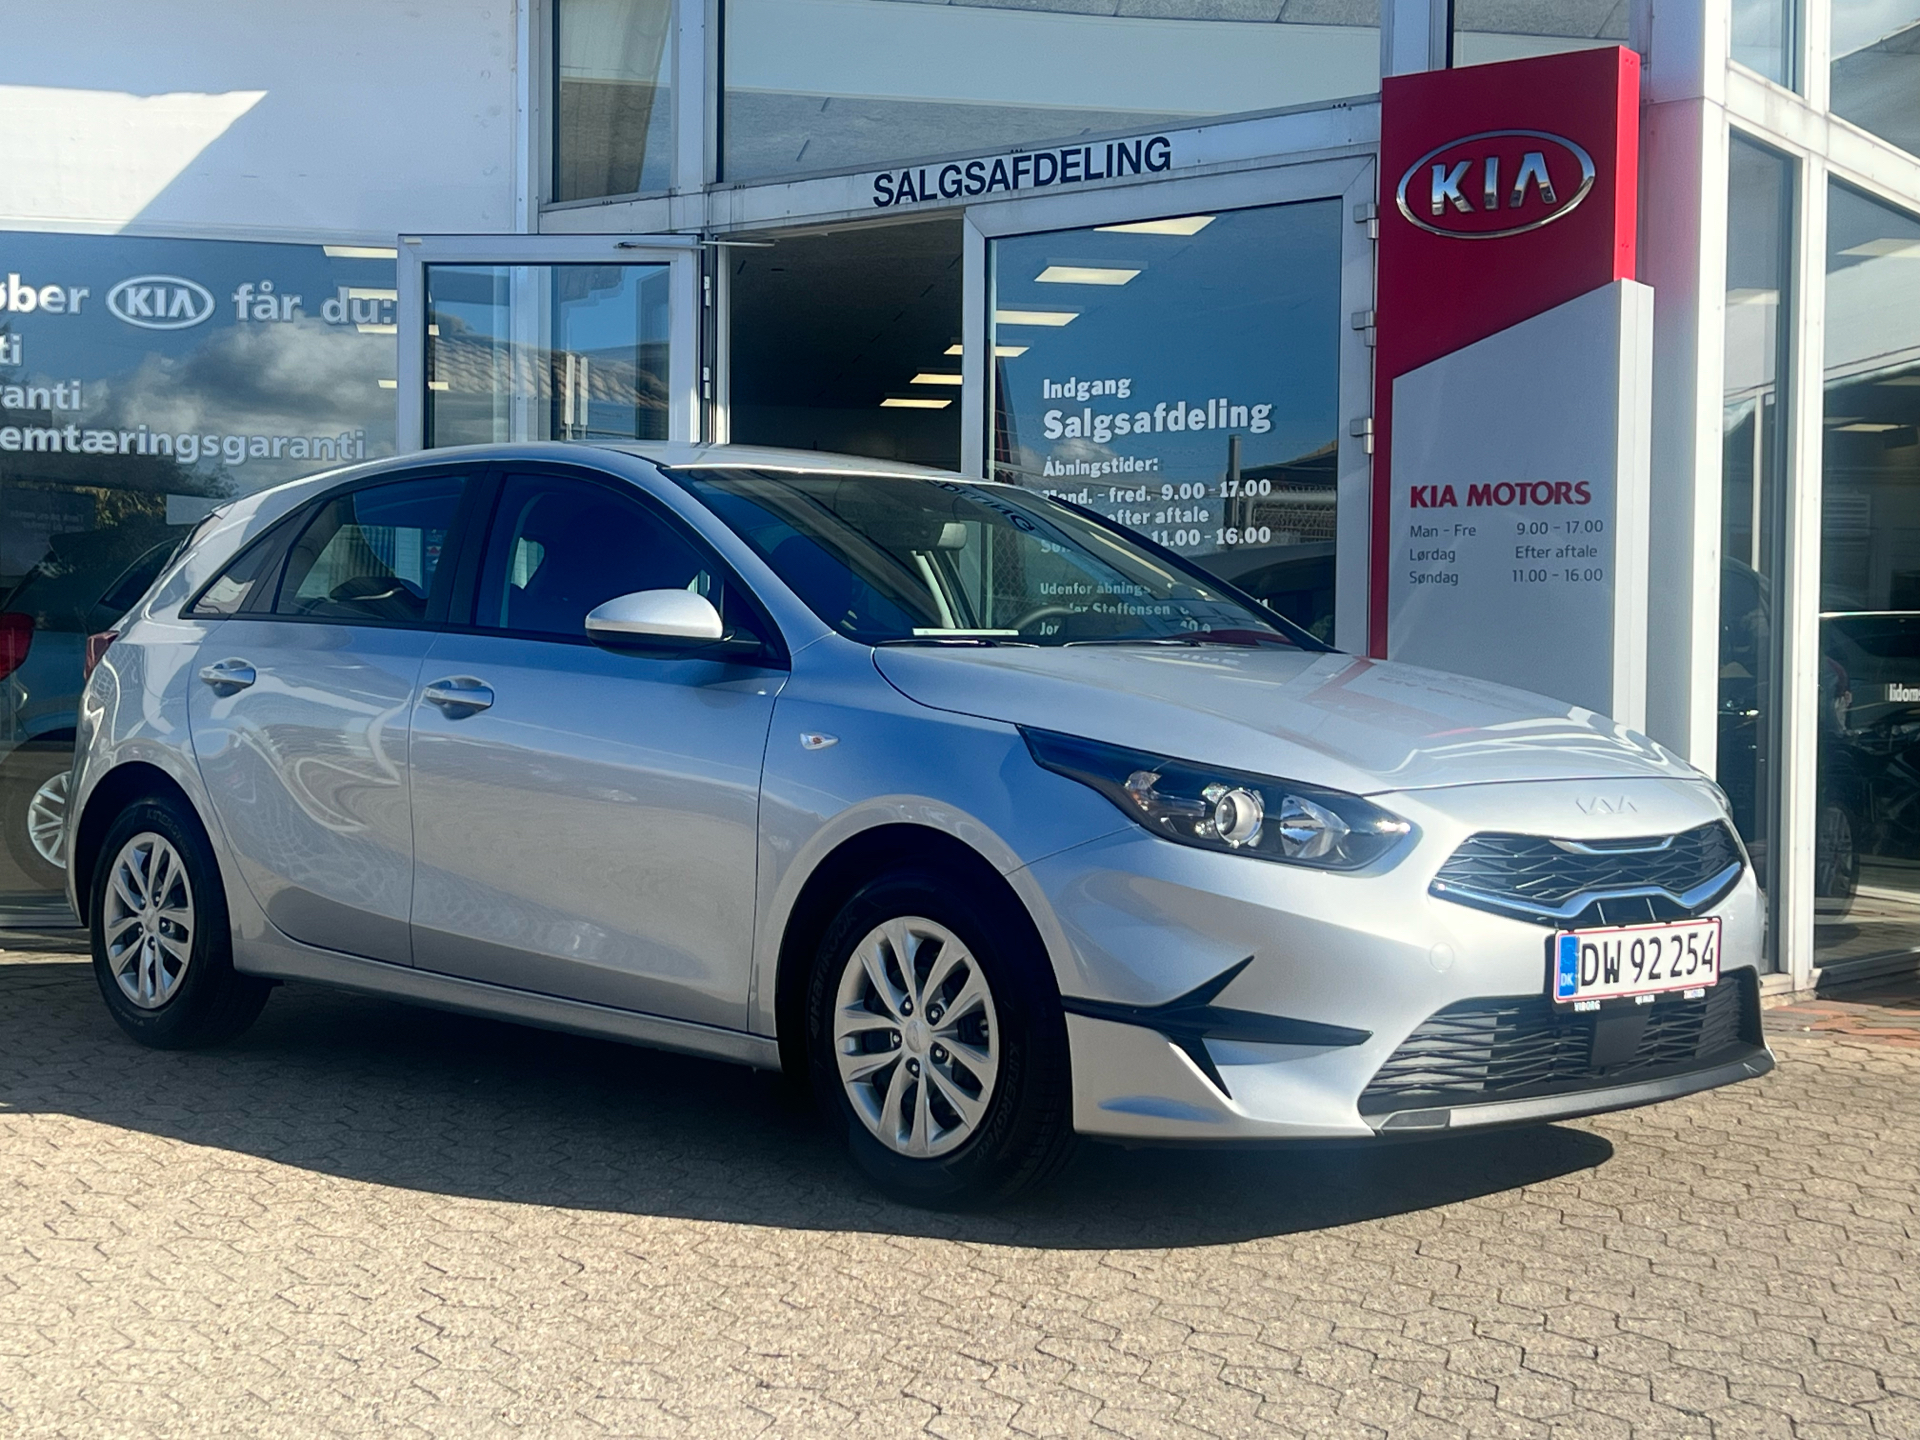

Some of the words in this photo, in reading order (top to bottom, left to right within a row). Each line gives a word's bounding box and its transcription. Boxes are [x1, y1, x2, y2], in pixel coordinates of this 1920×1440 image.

[872, 136, 1172, 208] SALGSAFDELING
[1431, 152, 1557, 216] KIA
[0, 273, 90, 315] ber
[125, 286, 197, 318] KIA
[232, 280, 302, 323] får
[320, 286, 395, 324] du:
[0, 378, 82, 411] anti
[1042, 376, 1132, 402] Indgang
[1042, 398, 1273, 443] Salgsafdeling
[1042, 456, 1160, 479] Åbningstider:
[1109, 485, 1151, 503] fred.
[1161, 482, 1205, 500] 9.00
[1219, 479, 1271, 498] 17.00
[1409, 484, 1459, 509] KIA
[1466, 481, 1592, 507] MOTORS
[1154, 506, 1210, 524] aftale
[1151, 528, 1200, 547] 11.00
[1216, 526, 1271, 545] 16.00
[1409, 525, 1439, 538] Man
[1453, 524, 1477, 537] Fre
[1516, 522, 1549, 536] 9.00
[1565, 519, 1604, 535] 17.00
[1409, 548, 1456, 563] Lørdag
[1515, 545, 1551, 559] Efter
[1555, 544, 1598, 558] aftale
[1039, 582, 1093, 595] Udenfor
[1409, 571, 1459, 586] Søndag
[1512, 569, 1548, 583] 11.00
[1564, 568, 1604, 583] 16.00
[1581, 940, 1622, 986] DW
[1630, 936, 1662, 983] 92
[1670, 931, 1714, 978] 254
[1560, 972, 1574, 986] DK
